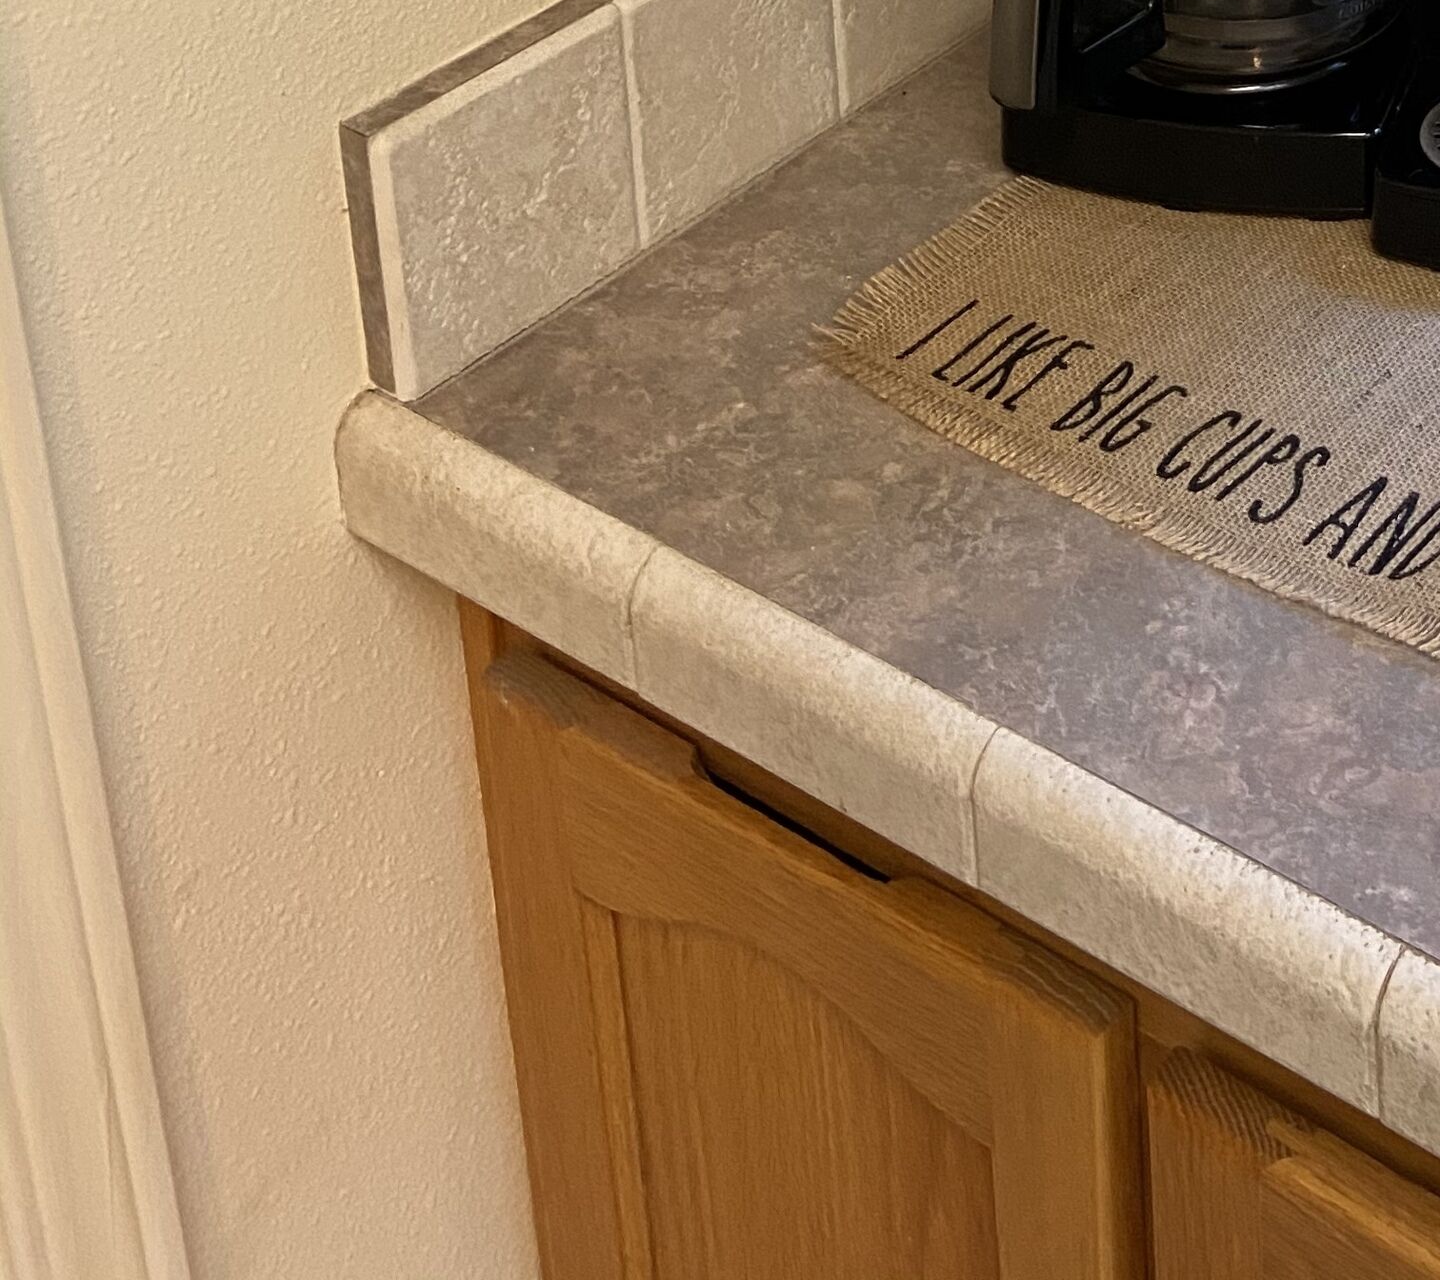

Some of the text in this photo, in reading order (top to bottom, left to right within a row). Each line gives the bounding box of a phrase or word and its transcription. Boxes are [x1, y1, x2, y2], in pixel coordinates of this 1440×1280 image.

[895, 299, 979, 360] I
[932, 313, 1095, 413] LIKE
[1049, 360, 1187, 454] BIG
[1155, 409, 1332, 526] CUPS
